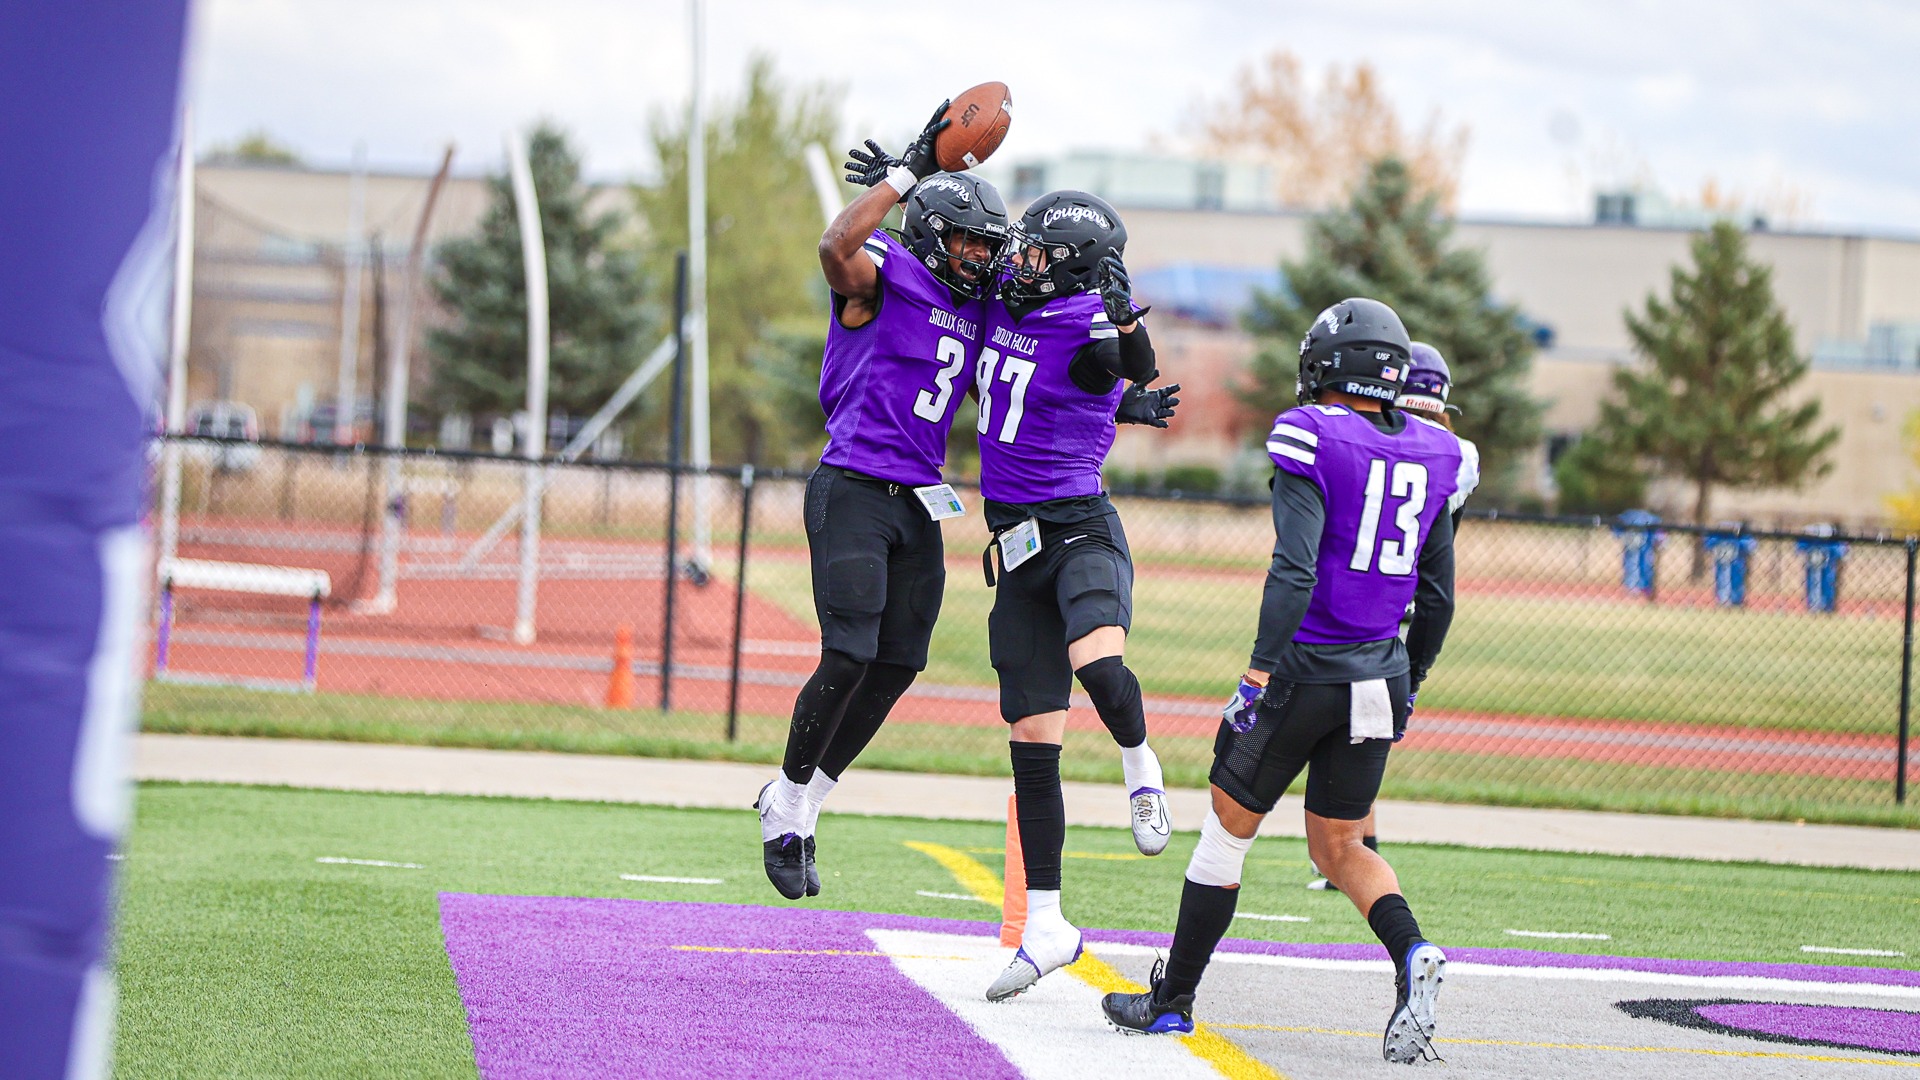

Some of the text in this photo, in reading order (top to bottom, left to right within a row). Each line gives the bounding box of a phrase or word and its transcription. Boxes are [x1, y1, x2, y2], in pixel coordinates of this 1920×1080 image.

[961, 104, 980, 128] USF
[916, 178, 972, 203] Cougars
[1043, 206, 1109, 229] Cougars
[929, 307, 977, 341] SIOUX FALLS
[992, 326, 1039, 356] SIOUX FALLS
[1375, 352, 1391, 361] USF
[913, 335, 965, 424] 3
[1346, 381, 1395, 401] Riddell
[976, 346, 1037, 445] 87
[1406, 398, 1441, 412] Riddell
[1349, 458, 1429, 577] 13
